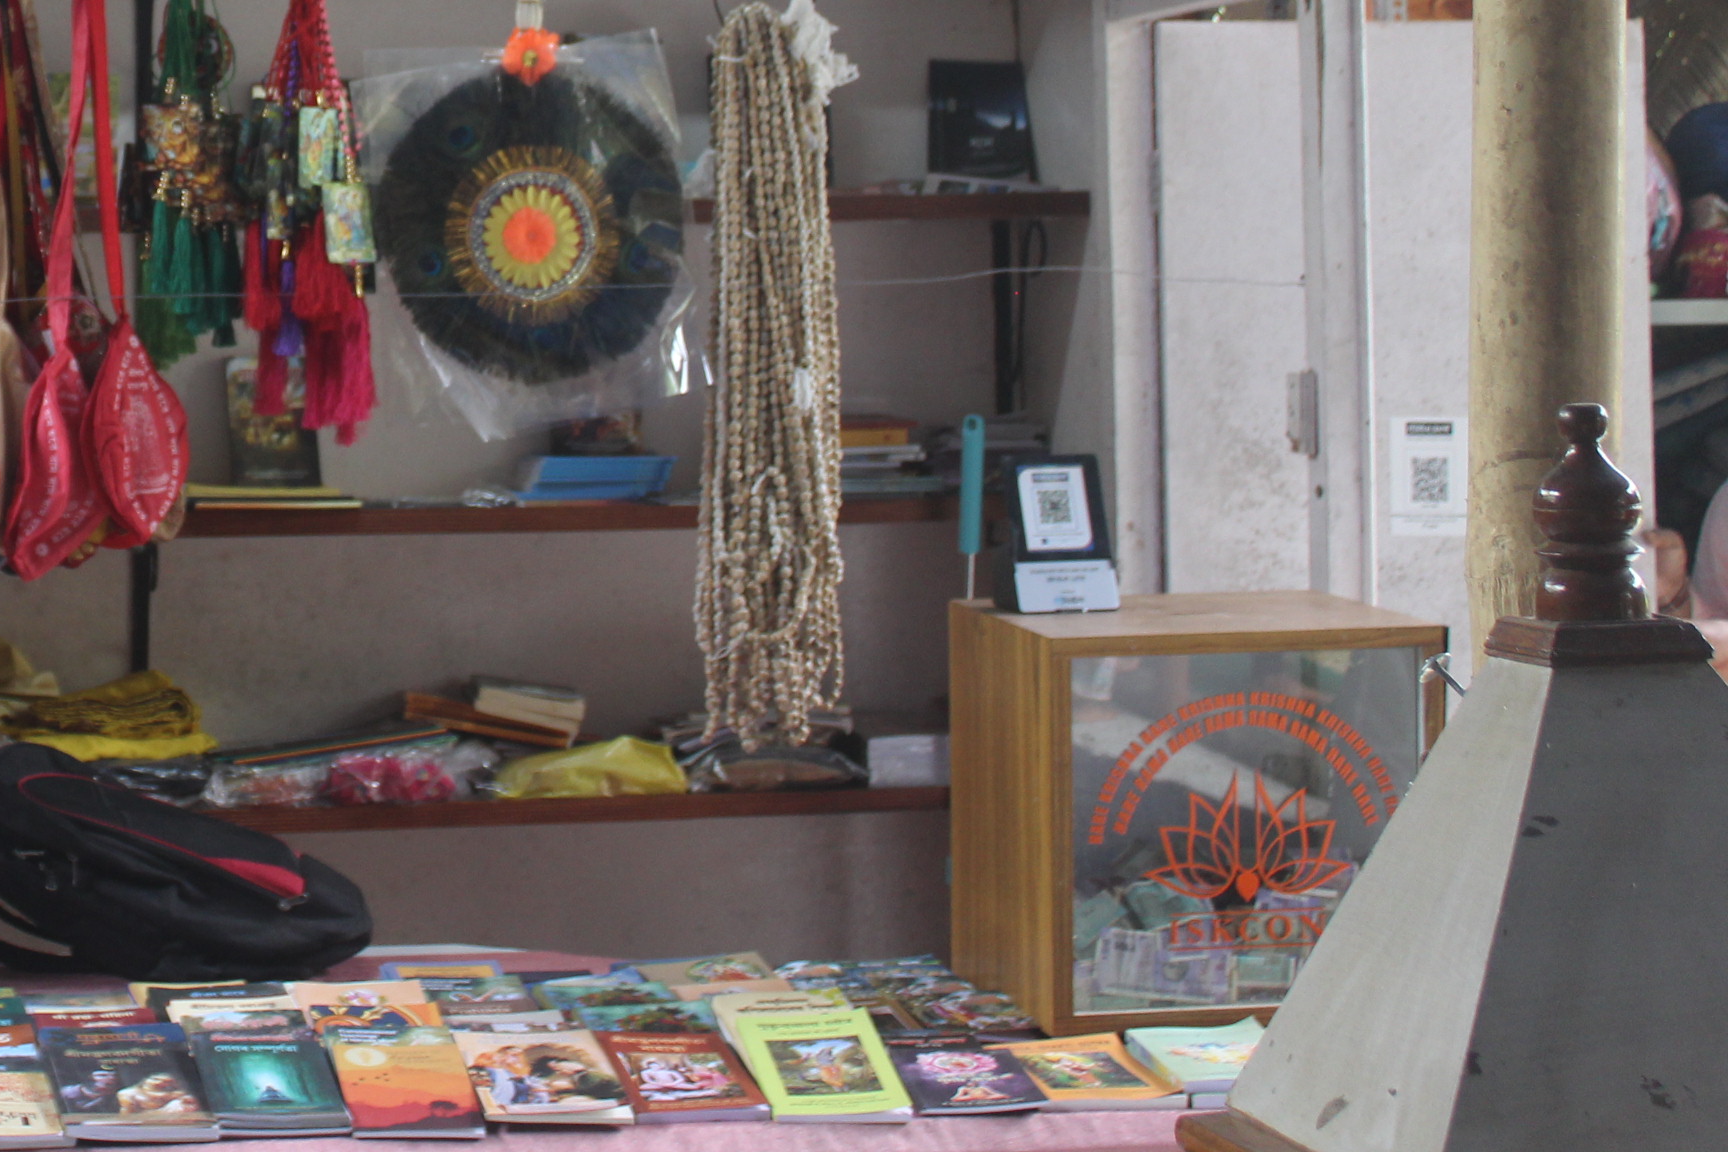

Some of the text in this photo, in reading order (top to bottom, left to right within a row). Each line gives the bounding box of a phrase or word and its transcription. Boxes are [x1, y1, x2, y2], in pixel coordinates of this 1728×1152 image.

[1177, 691, 1245, 722] KRISHNA
[1249, 691, 1317, 718] KRISHNA
[1315, 709, 1373, 760] KRISHNA
[1248, 709, 1289, 732] RAMA
[1168, 913, 1328, 945] ISKCON
